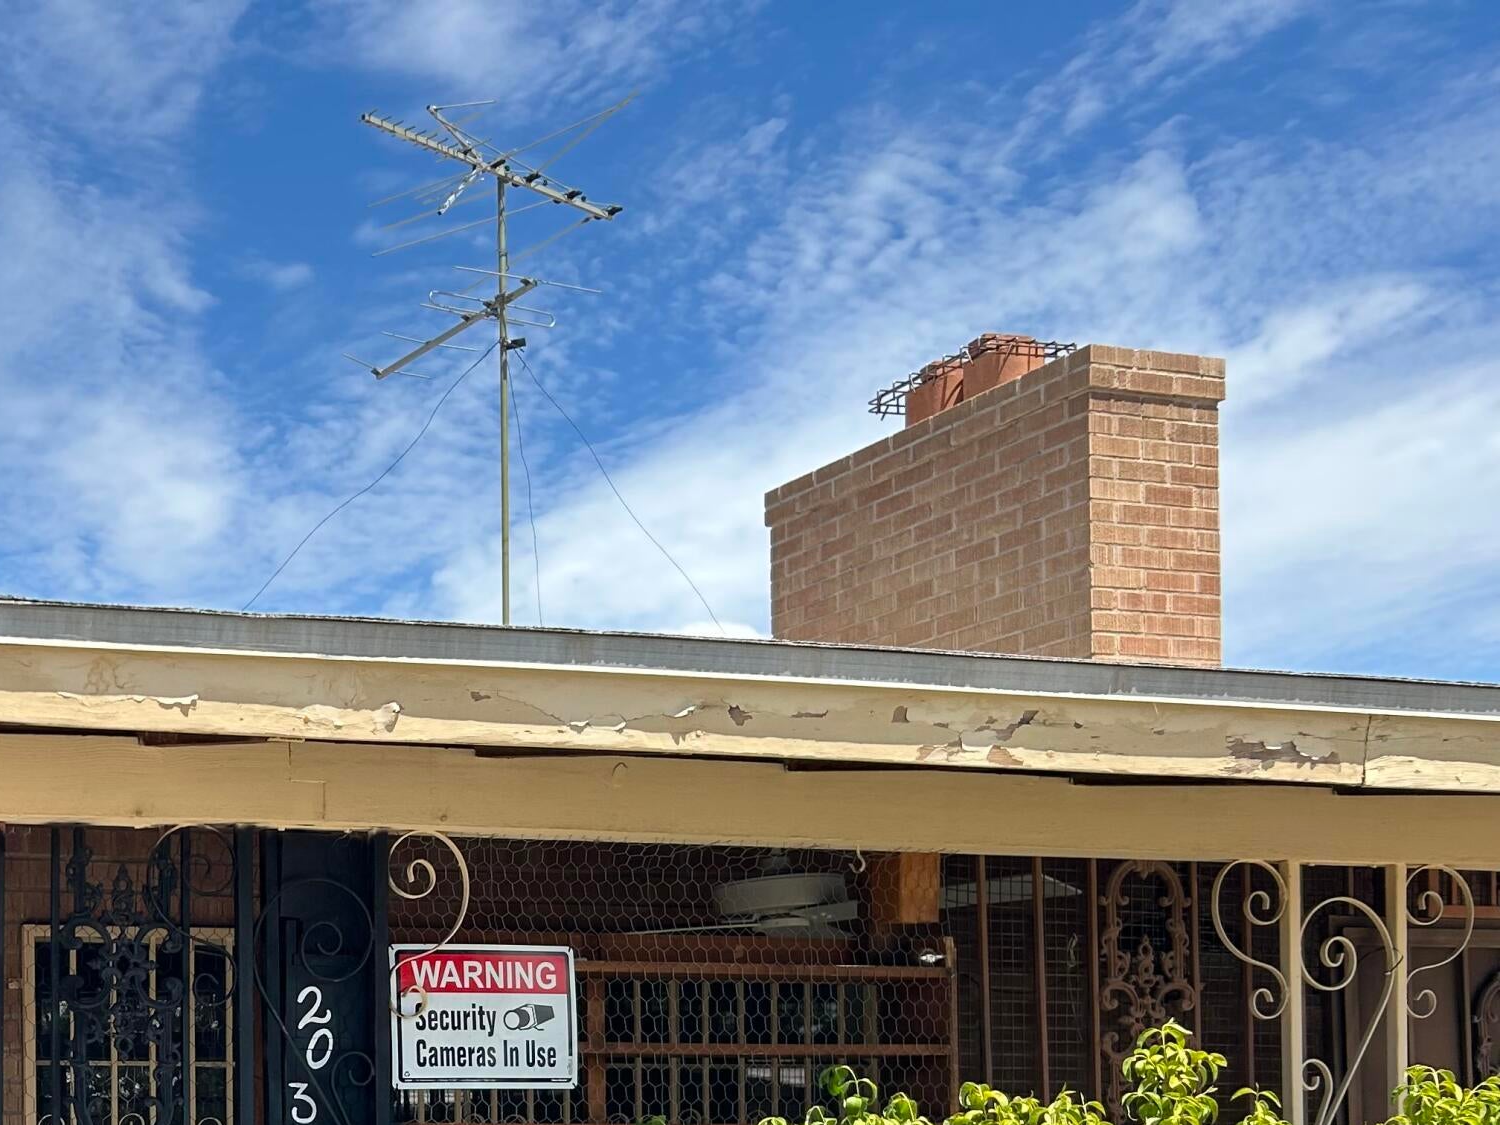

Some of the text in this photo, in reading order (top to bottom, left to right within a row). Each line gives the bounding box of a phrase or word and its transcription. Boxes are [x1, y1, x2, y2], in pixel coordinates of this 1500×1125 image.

[410, 960, 557, 990] WARNING
[415, 1003, 497, 1037] Security
[415, 1039, 497, 1068] Cameras
[503, 1039, 520, 1067] In
[525, 1039, 557, 1068] Use
